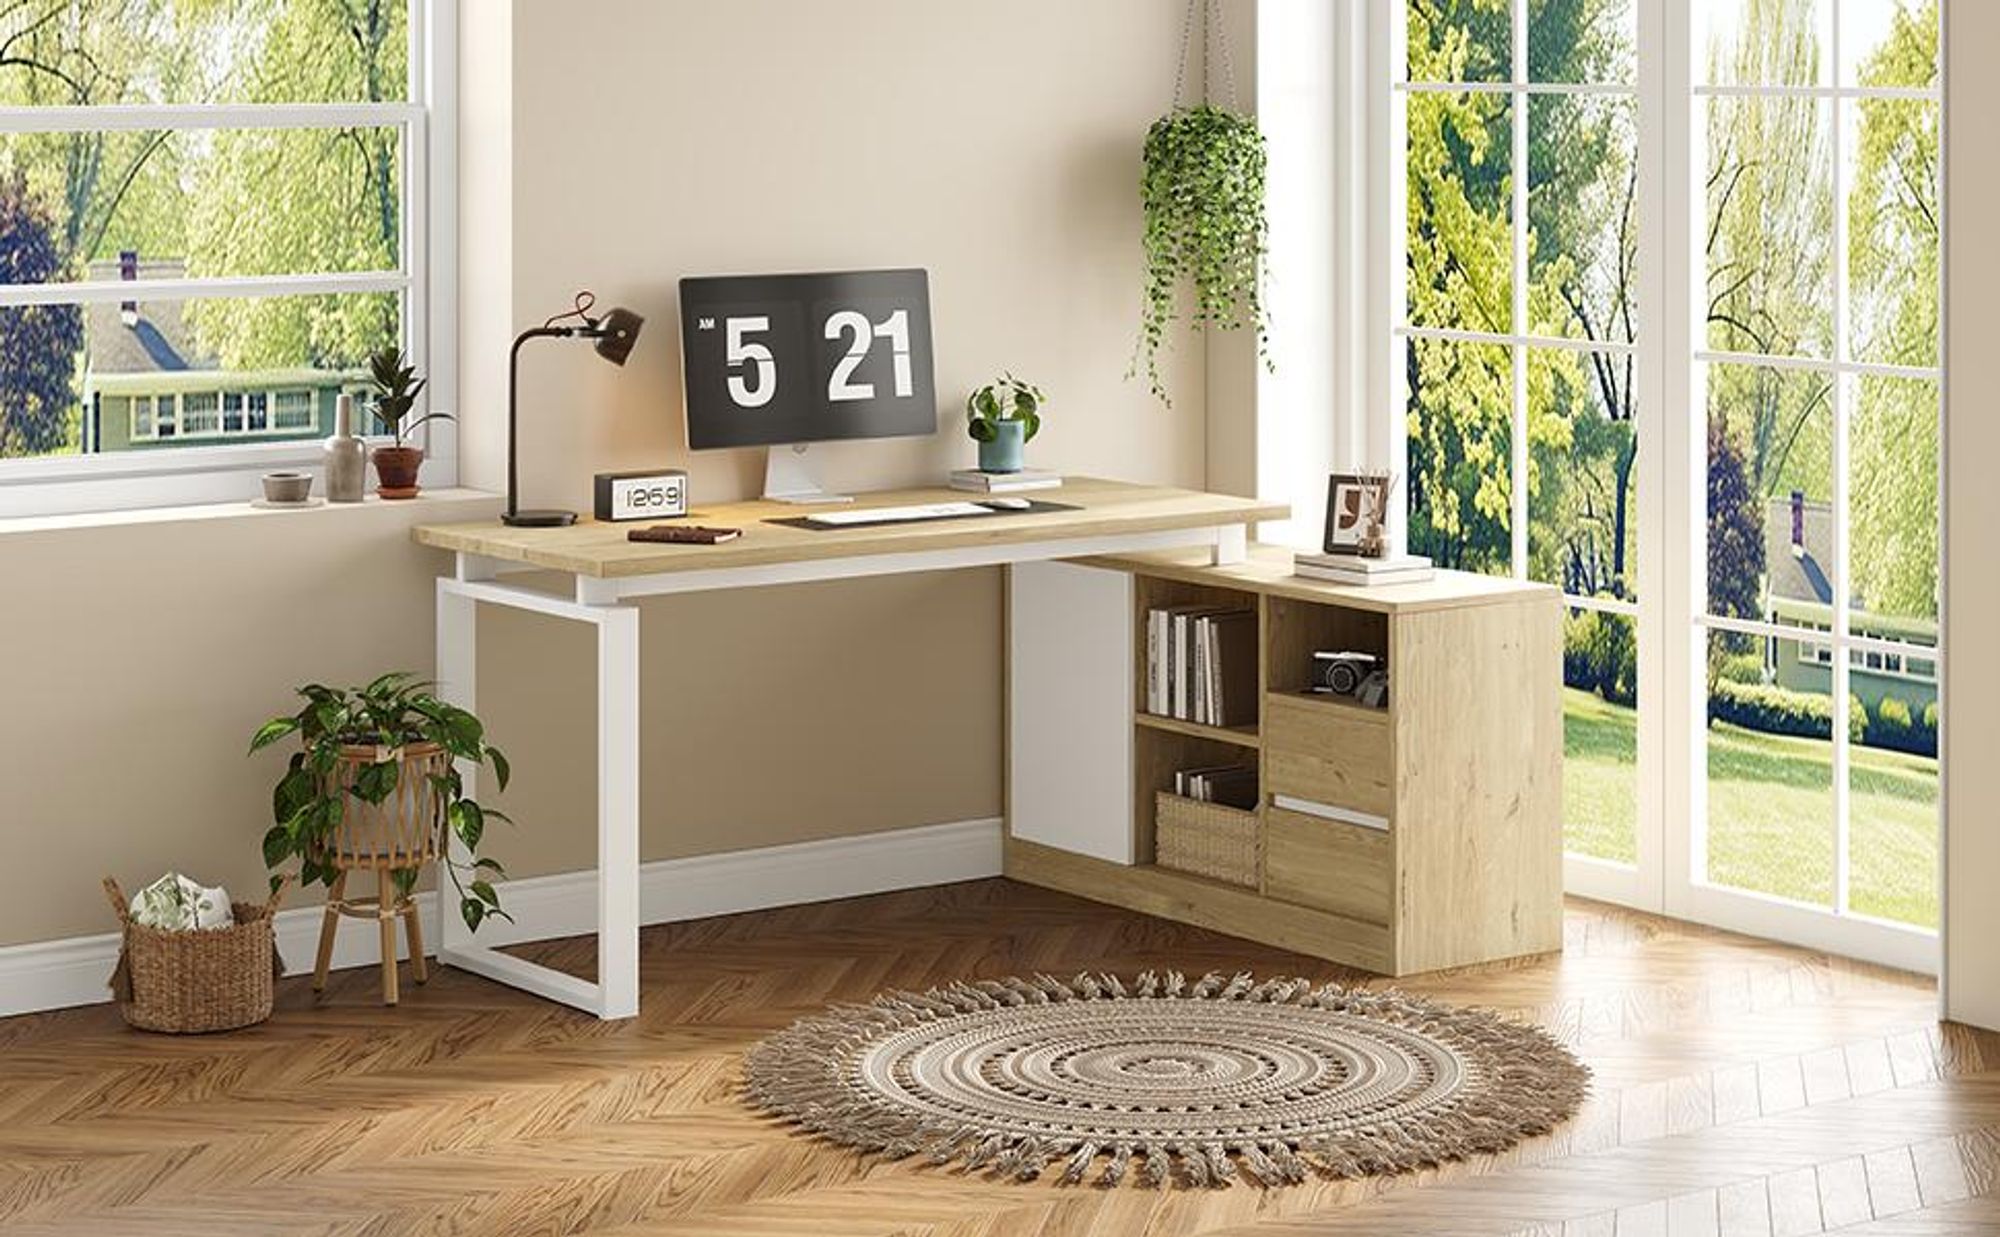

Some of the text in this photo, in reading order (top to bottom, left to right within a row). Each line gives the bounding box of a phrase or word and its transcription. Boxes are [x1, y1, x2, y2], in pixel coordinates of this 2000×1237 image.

[698, 309, 913, 408] AM 5 21
